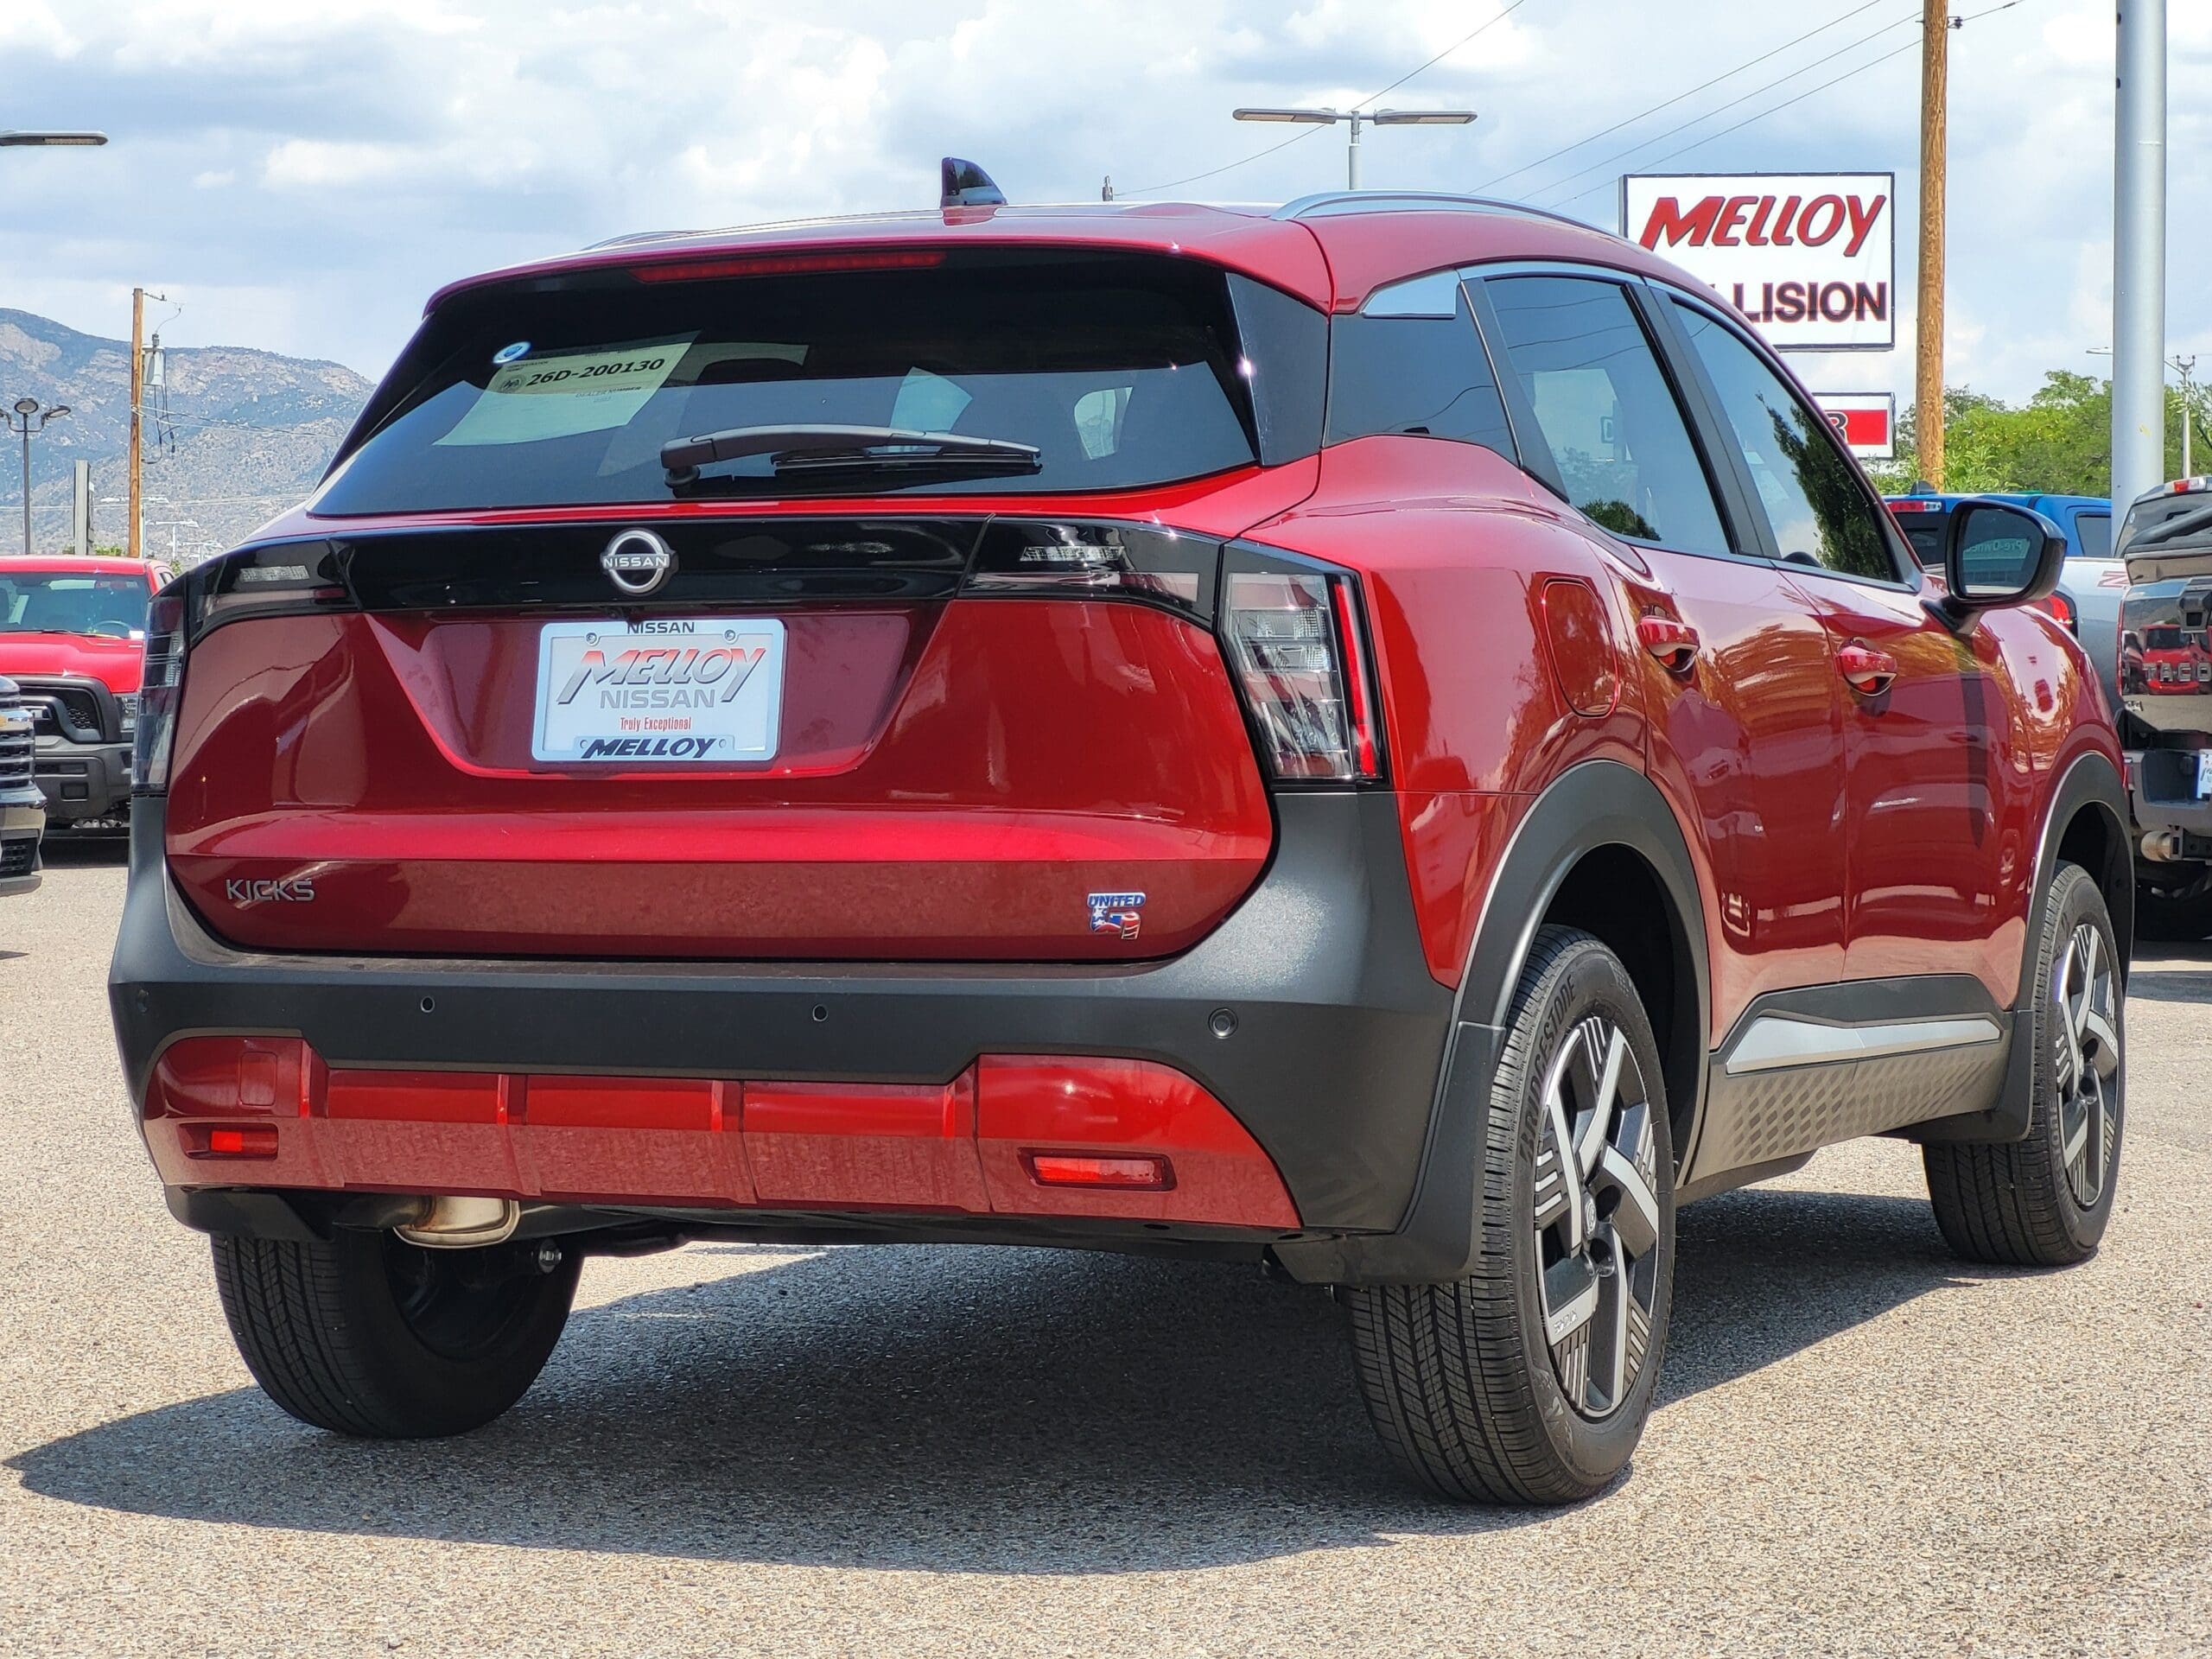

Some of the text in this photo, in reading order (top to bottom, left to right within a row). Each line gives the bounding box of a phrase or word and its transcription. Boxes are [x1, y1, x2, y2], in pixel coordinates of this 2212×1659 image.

[1638, 194, 1886, 257] MELLOY
[1711, 281, 1887, 322] LISION
[526, 359, 665, 386] 26D-200130
[603, 556, 668, 568] NISSAN
[626, 621, 695, 634] NISSAN
[556, 647, 766, 705] MELLOY
[600, 689, 715, 709] NISSAN
[620, 716, 691, 732] Truly Exceptional
[581, 737, 717, 759] MELLOY
[226, 879, 315, 901] KICKS
[1088, 894, 1144, 907] UNITED
